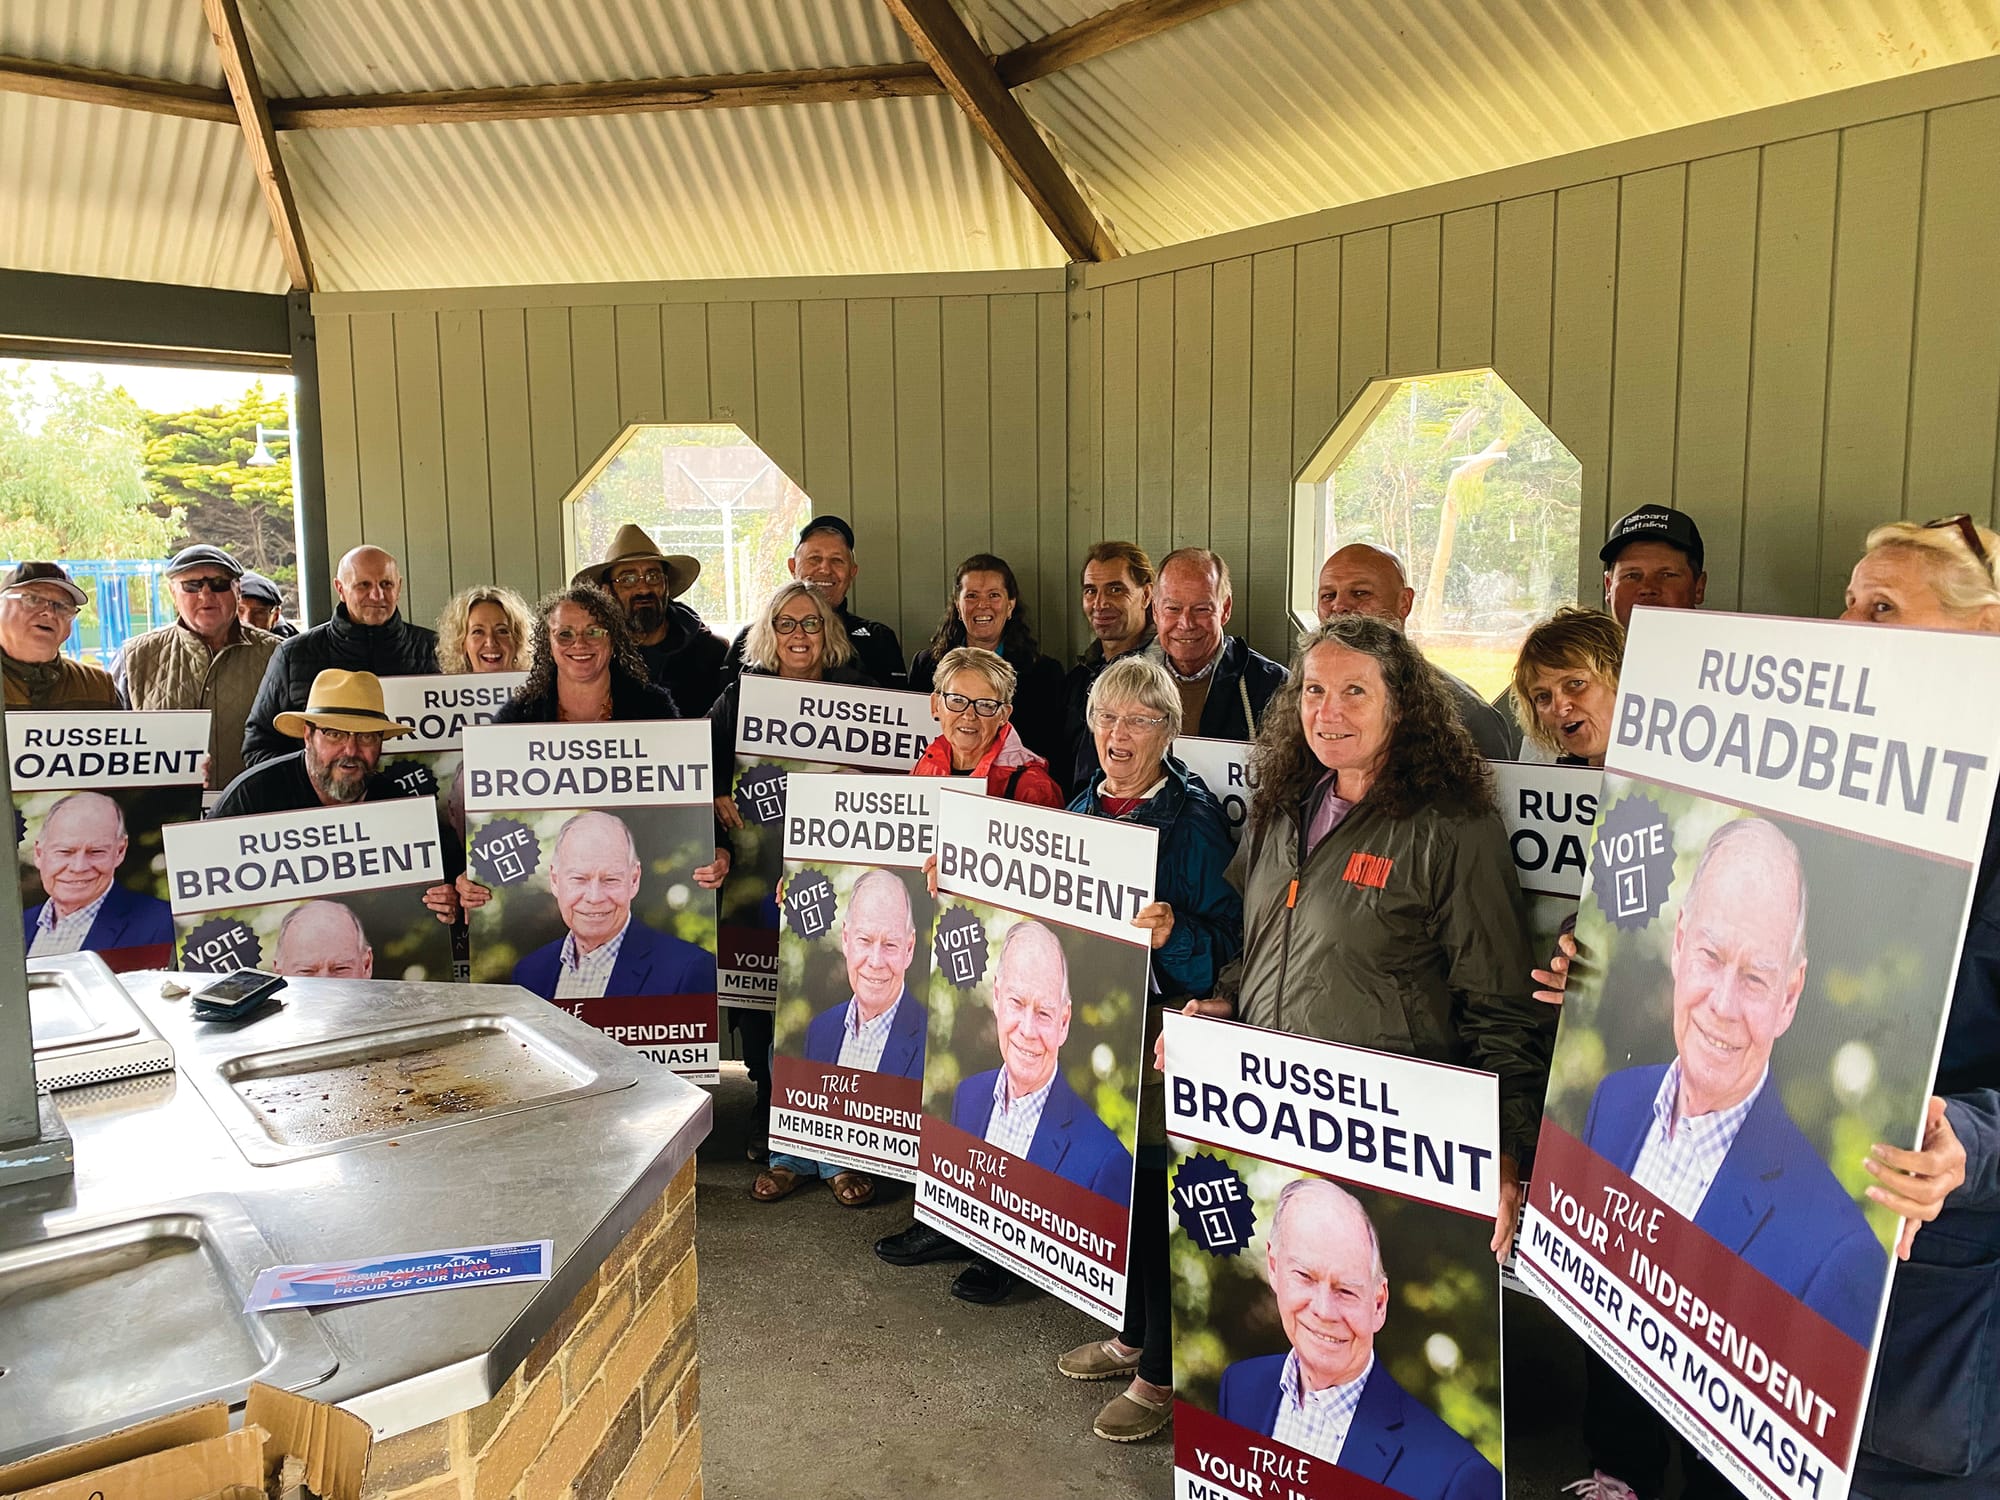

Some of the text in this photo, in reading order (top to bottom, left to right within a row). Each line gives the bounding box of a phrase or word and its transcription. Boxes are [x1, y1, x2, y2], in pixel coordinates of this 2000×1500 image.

[1698, 648, 1876, 717] RUSSELL
[800, 697, 908, 726] RUSSELL
[25, 728, 147, 747] RUSSELL
[529, 739, 648, 761] RUSSELL
[1616, 692, 1988, 824] BROADBENT
[471, 764, 708, 798] BROADBENT
[740, 776, 787, 800] VOTE
[763, 802, 776, 816] 1
[835, 791, 930, 816] RUSSELL
[239, 822, 370, 856] RUSSELL
[474, 829, 529, 862] VOTE
[789, 818, 936, 854] BROADBE
[988, 819, 1090, 866] RUSSELL
[1600, 824, 1665, 867] VOTE
[176, 841, 436, 900] BROADBENT
[502, 859, 516, 876] 1
[941, 843, 1148, 921] BROADBENT
[788, 881, 829, 911] VOTE
[1624, 875, 1638, 906] 1
[807, 911, 817, 928] 1
[187, 926, 249, 966] VOTE
[938, 923, 981, 951] VOTE
[958, 955, 968, 975] 1
[785, 1088, 829, 1112] YOUR
[821, 1074, 861, 1093] TRUE
[1241, 1052, 1399, 1116] RUSSELL
[778, 1113, 843, 1142] MEMBER
[847, 1127, 879, 1150] FOR
[1173, 1076, 1492, 1193] BROADBENT
[968, 1149, 1008, 1178] TRUE
[931, 1153, 1116, 1262] YOUR INDEPENDENT
[1177, 1177, 1241, 1210] VOTE
[1208, 1214, 1226, 1239] 1
[1603, 1186, 1665, 1244] TRUE
[924, 1181, 989, 1230] MEMBER
[993, 1217, 1026, 1249] FOR
[1030, 1235, 1114, 1296] MONASH
[333, 1284, 387, 1295] PROUD
[416, 1275, 448, 1284] OUR
[453, 1267, 511, 1280] NATION
[394, 1258, 487, 1274] AUSTRALIAN
[1550, 1182, 1836, 1438] YOUR INDEPENDENT
[1533, 1221, 1824, 1500] MEMBER FOR MONASH
[1195, 1448, 1263, 1497] YOUR
[1248, 1446, 1311, 1484] TRUE
